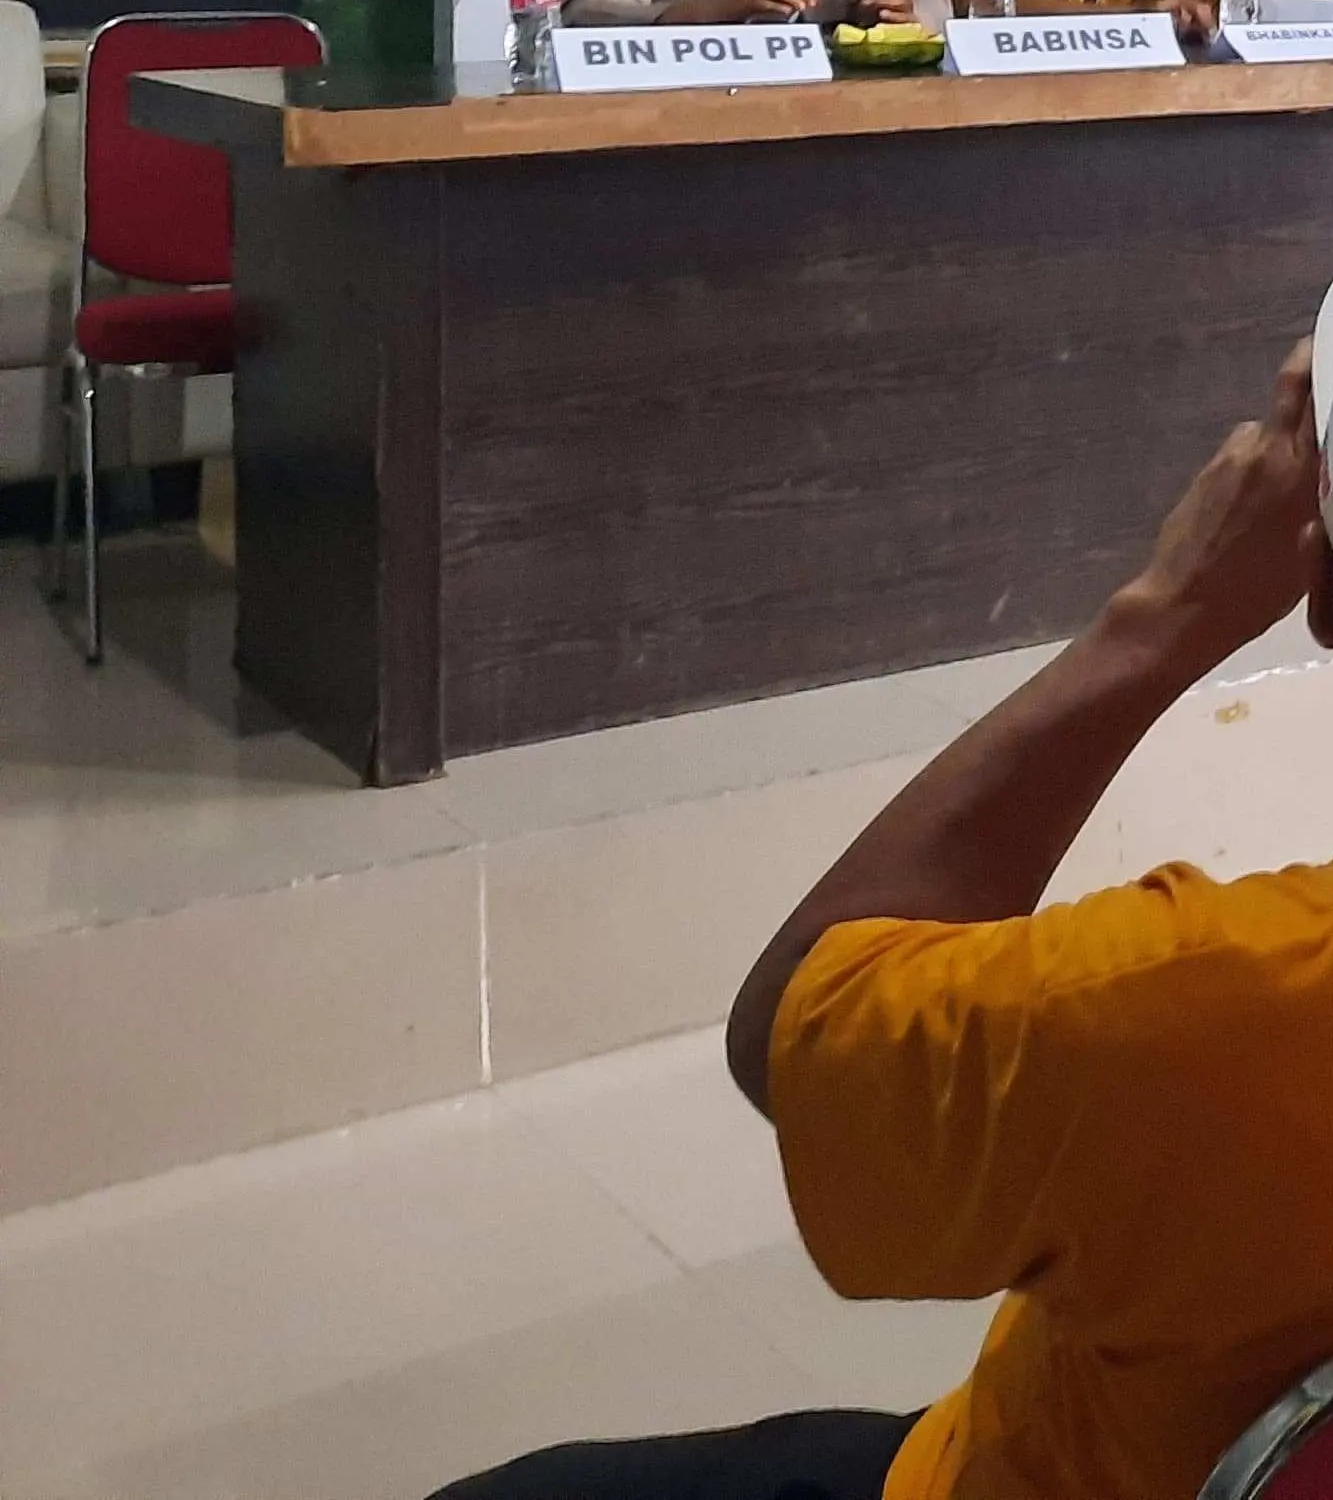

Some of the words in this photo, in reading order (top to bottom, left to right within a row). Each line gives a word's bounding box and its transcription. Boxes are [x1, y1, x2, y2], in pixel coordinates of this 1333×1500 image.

[582, 38, 657, 66] BIN
[671, 37, 753, 63] POL
[763, 35, 813, 61] PP
[993, 27, 1152, 54] BABINSA
